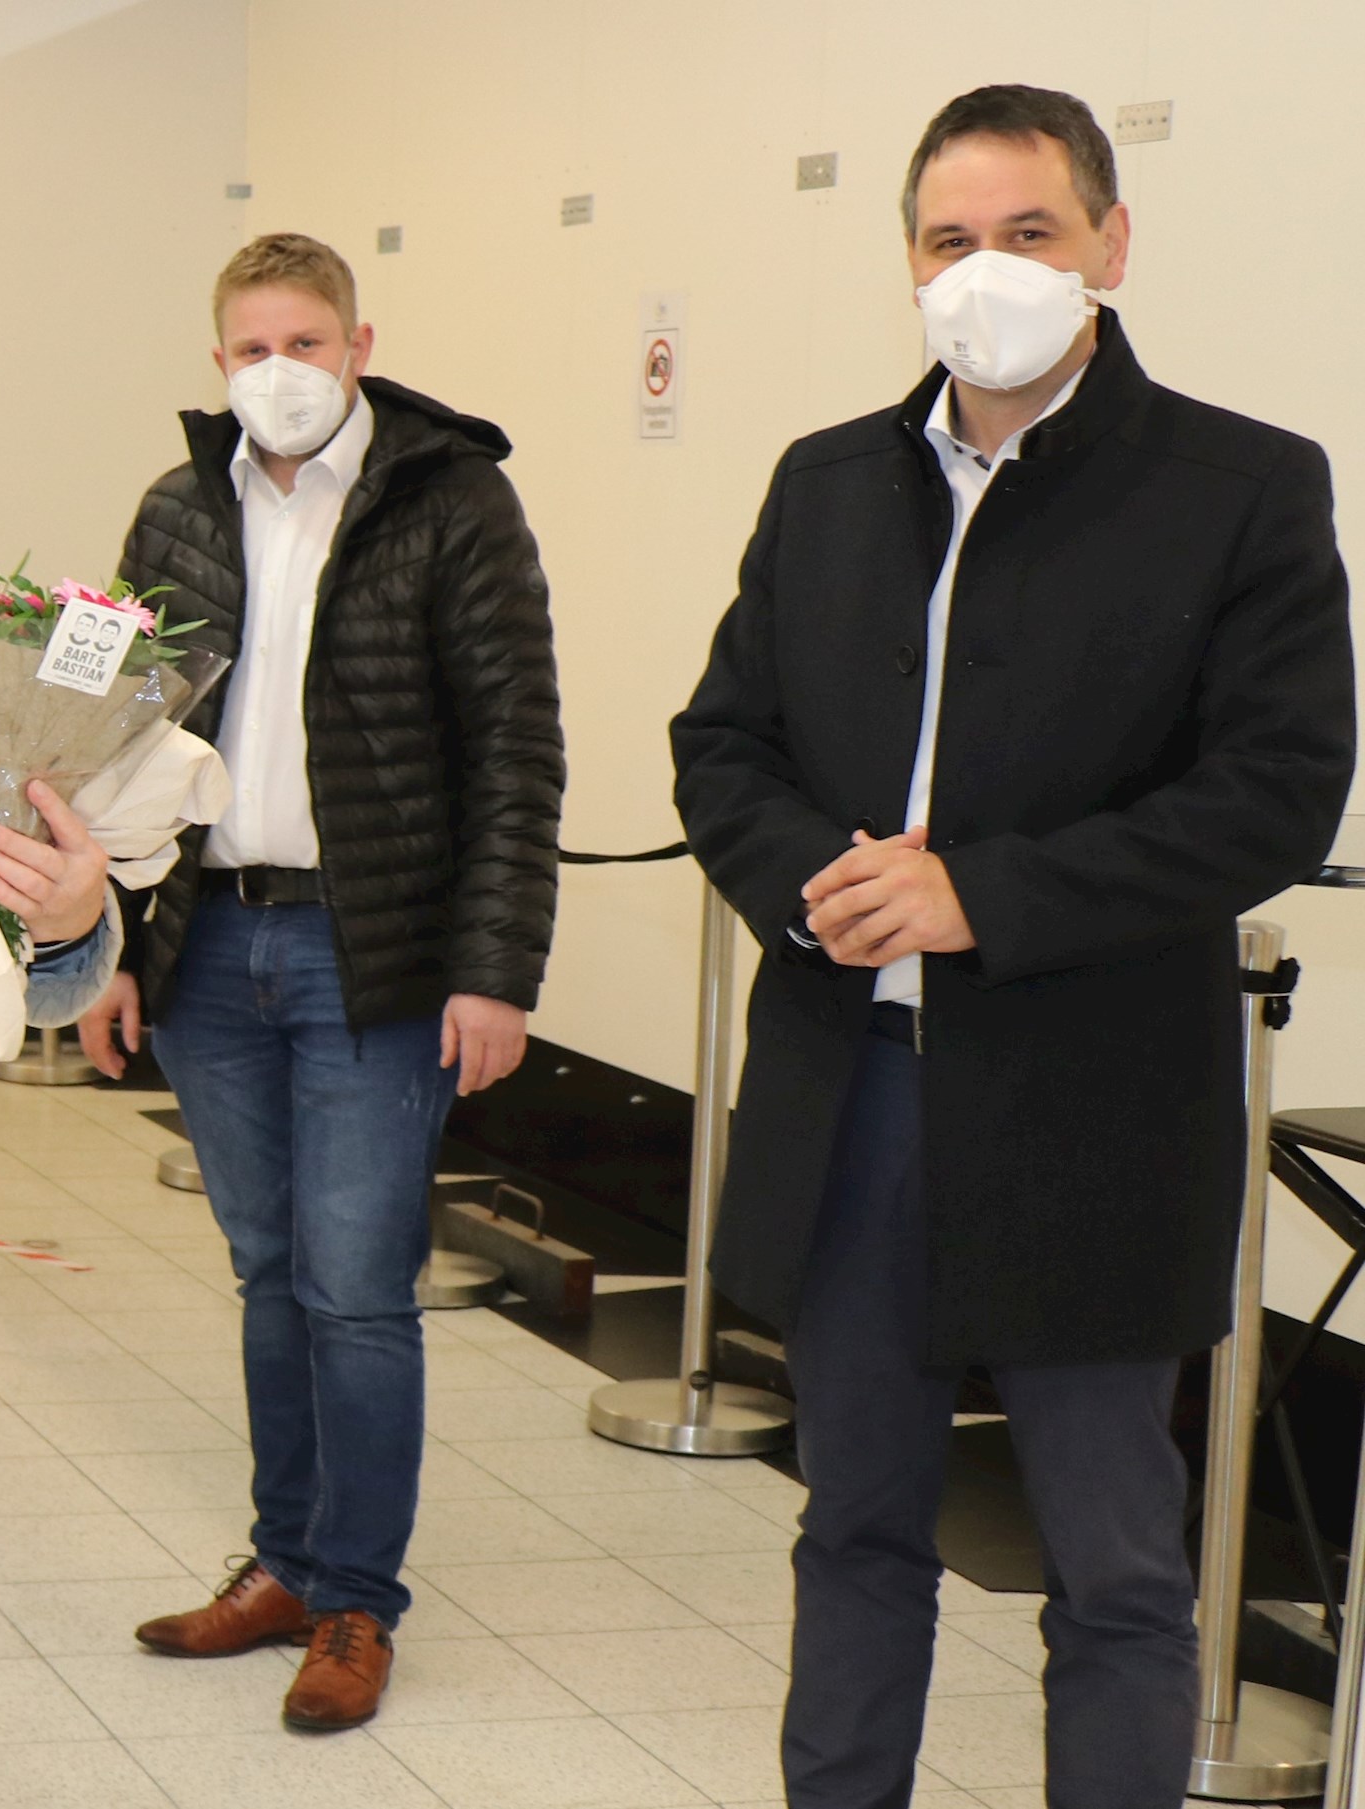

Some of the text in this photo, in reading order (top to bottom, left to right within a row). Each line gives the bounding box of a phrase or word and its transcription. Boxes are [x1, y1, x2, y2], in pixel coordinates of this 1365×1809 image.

[62, 646, 107, 668] BART &
[52, 658, 107, 683] BASTIAN
